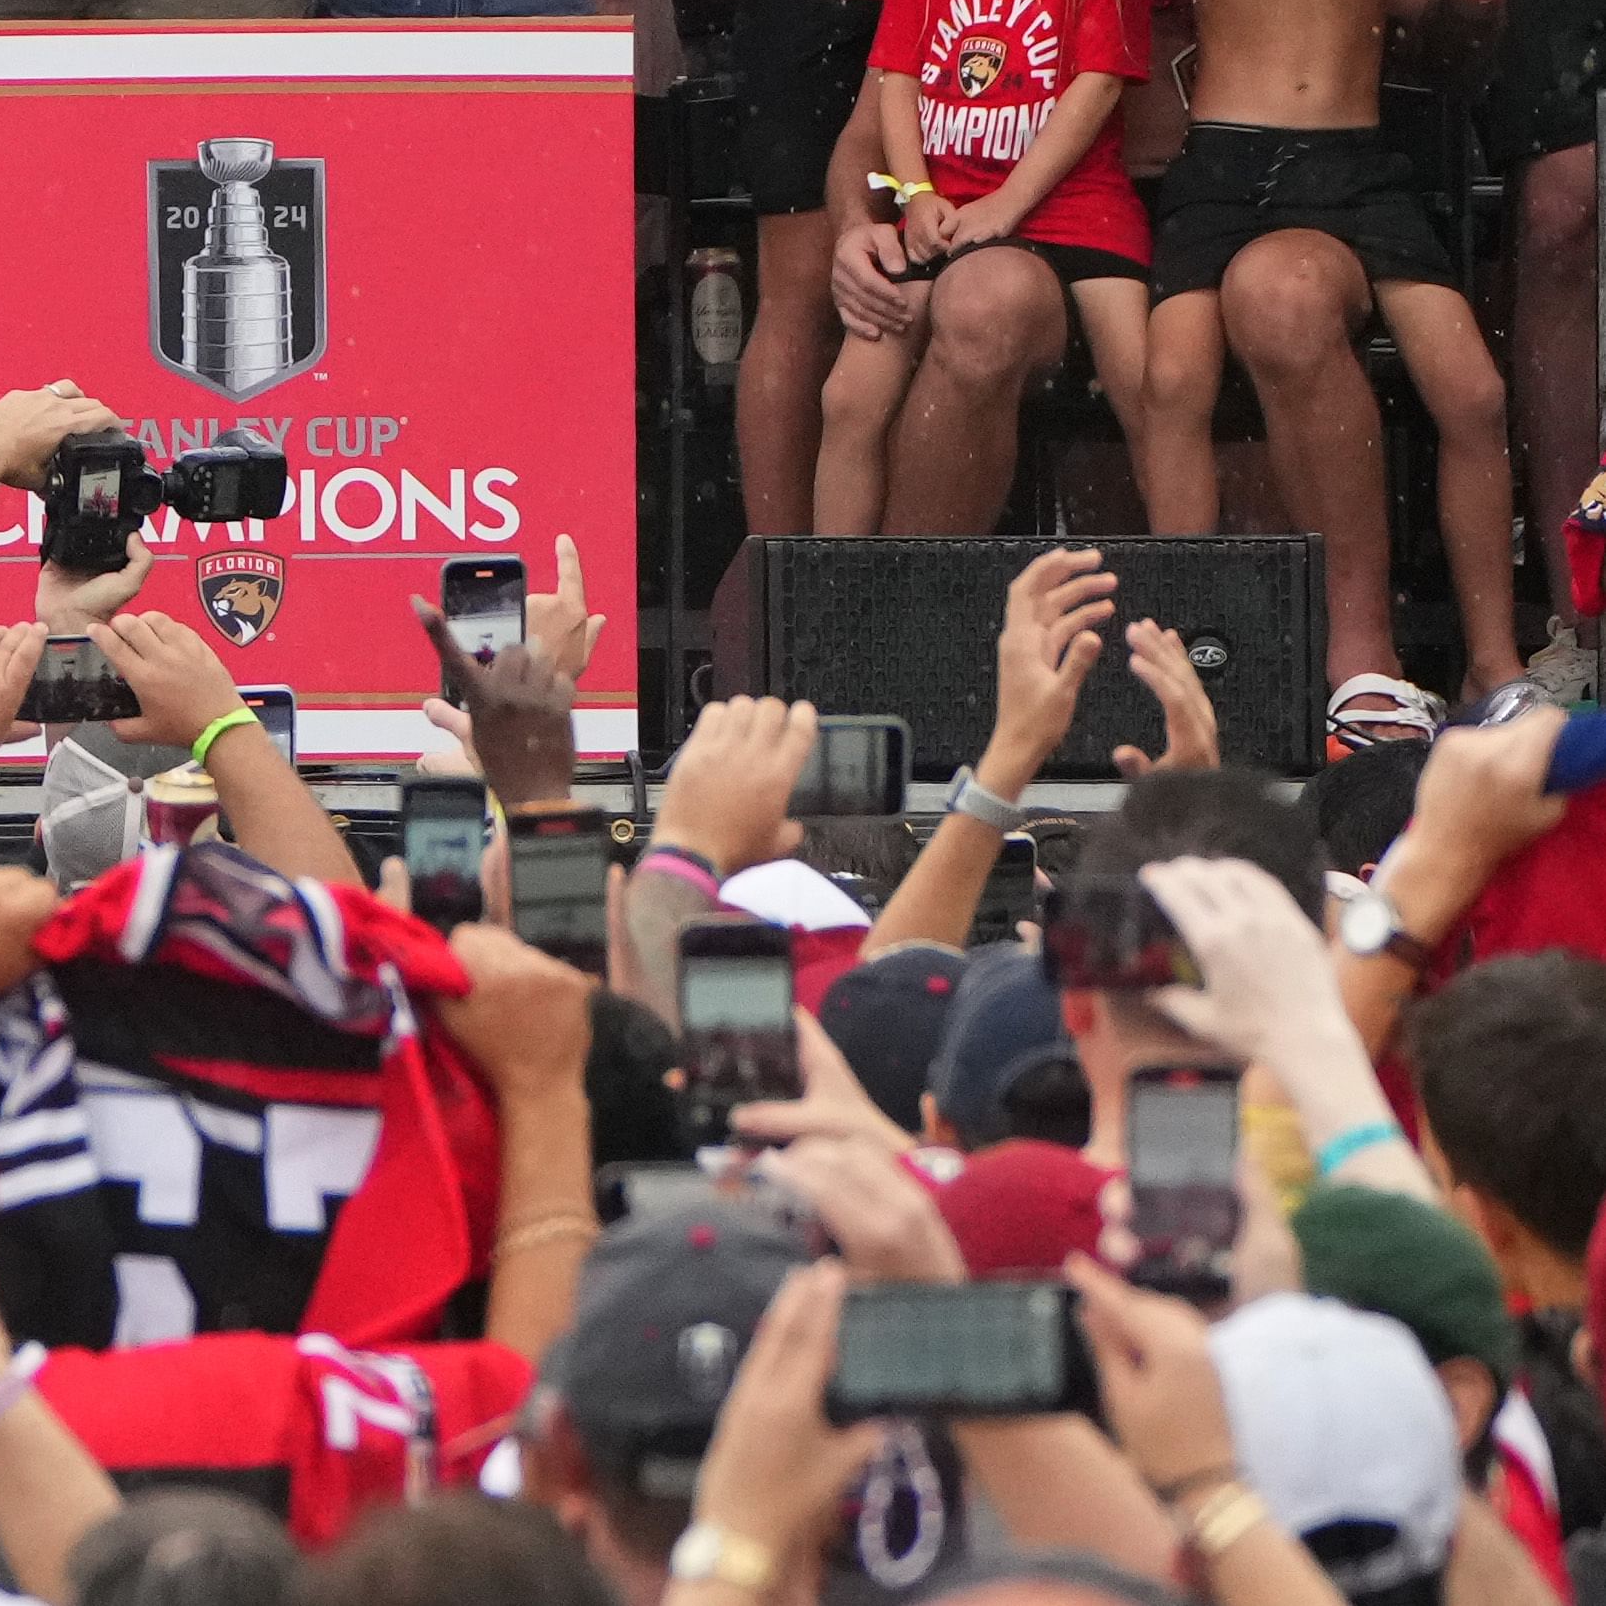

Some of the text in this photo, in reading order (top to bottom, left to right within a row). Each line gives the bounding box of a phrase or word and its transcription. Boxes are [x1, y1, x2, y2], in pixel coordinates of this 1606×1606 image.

[963, 39, 1005, 56] FLORIDA
[1021, 10, 1060, 91] CUP
[166, 205, 307, 230] 20 24
[305, 416, 400, 459] CUP
[205, 555, 277, 577] FLORIDA
